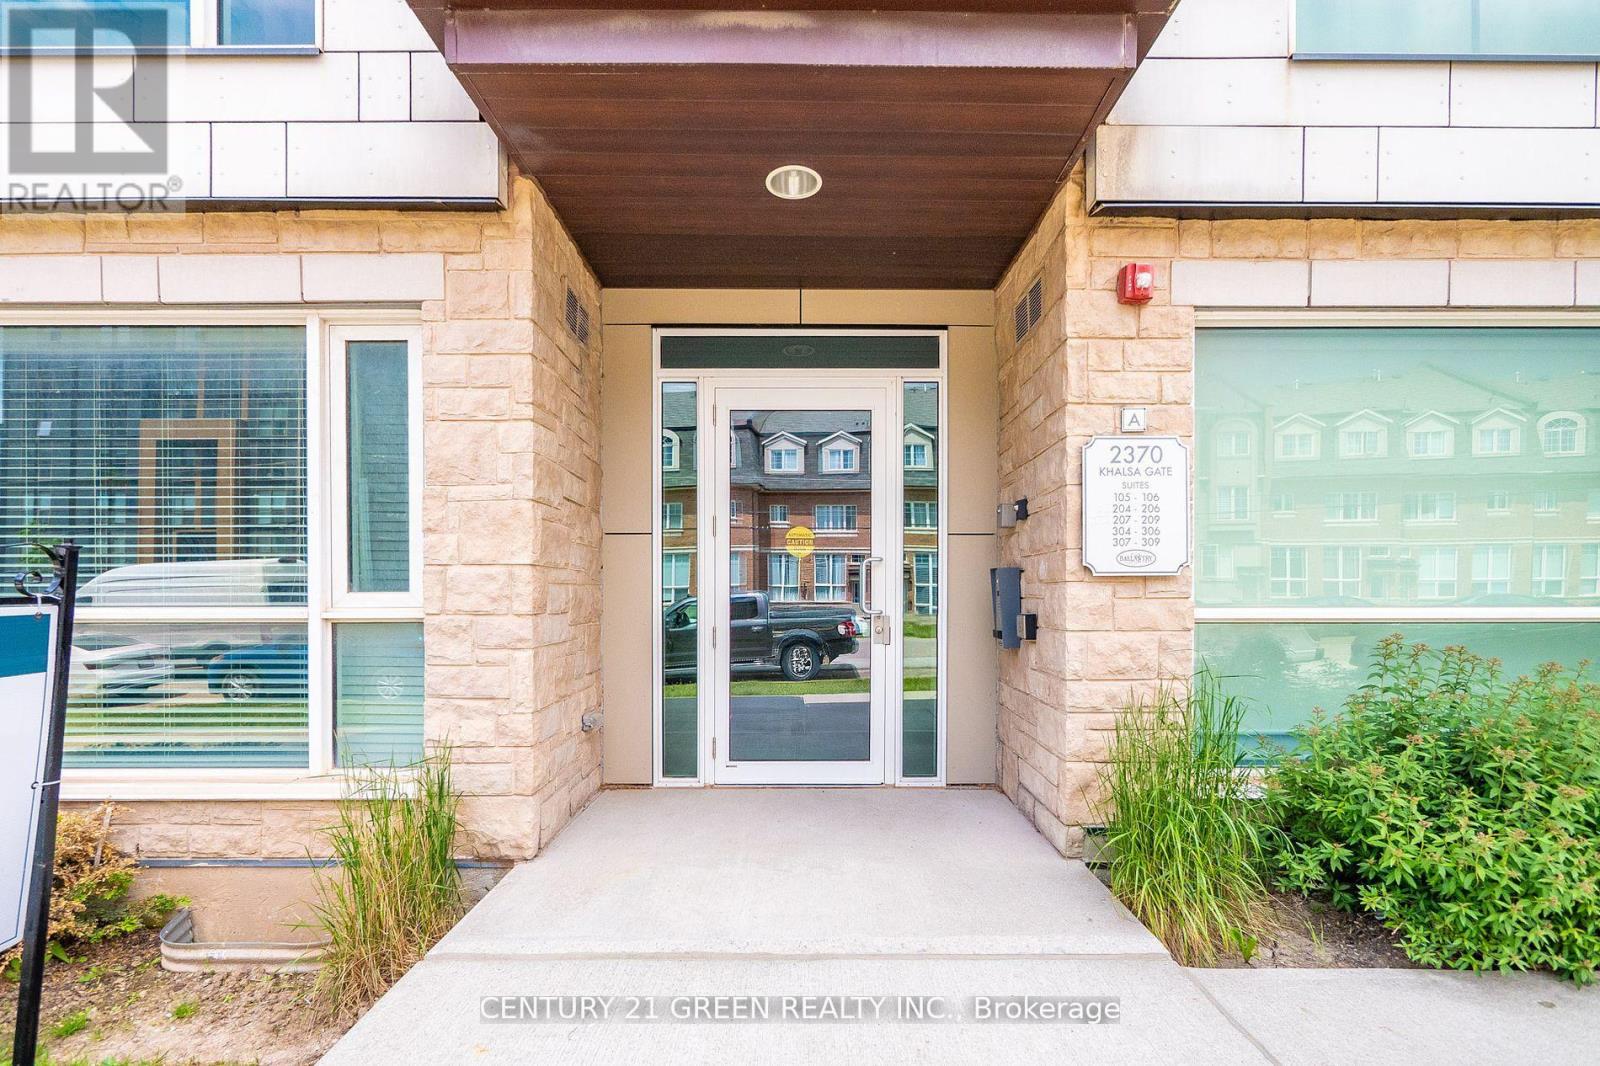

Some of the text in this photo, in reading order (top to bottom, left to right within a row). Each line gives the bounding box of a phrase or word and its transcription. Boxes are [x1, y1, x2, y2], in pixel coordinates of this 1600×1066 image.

[1128, 413, 1141, 426] A
[1110, 445, 1163, 464] 2370
[1099, 466, 1173, 477] KHALSA GATE
[1121, 481, 1150, 490] SUITES
[1114, 492, 1131, 502] 105
[1142, 492, 1160, 502] 106
[1112, 503, 1131, 513] 204
[1142, 503, 1160, 513] 206
[1112, 515, 1131, 525] 207
[1142, 515, 1160, 525] 209
[1112, 526, 1131, 536] 304
[1142, 526, 1160, 536] 306
[1112, 537, 1131, 547] 307
[1142, 537, 1160, 547] 309
